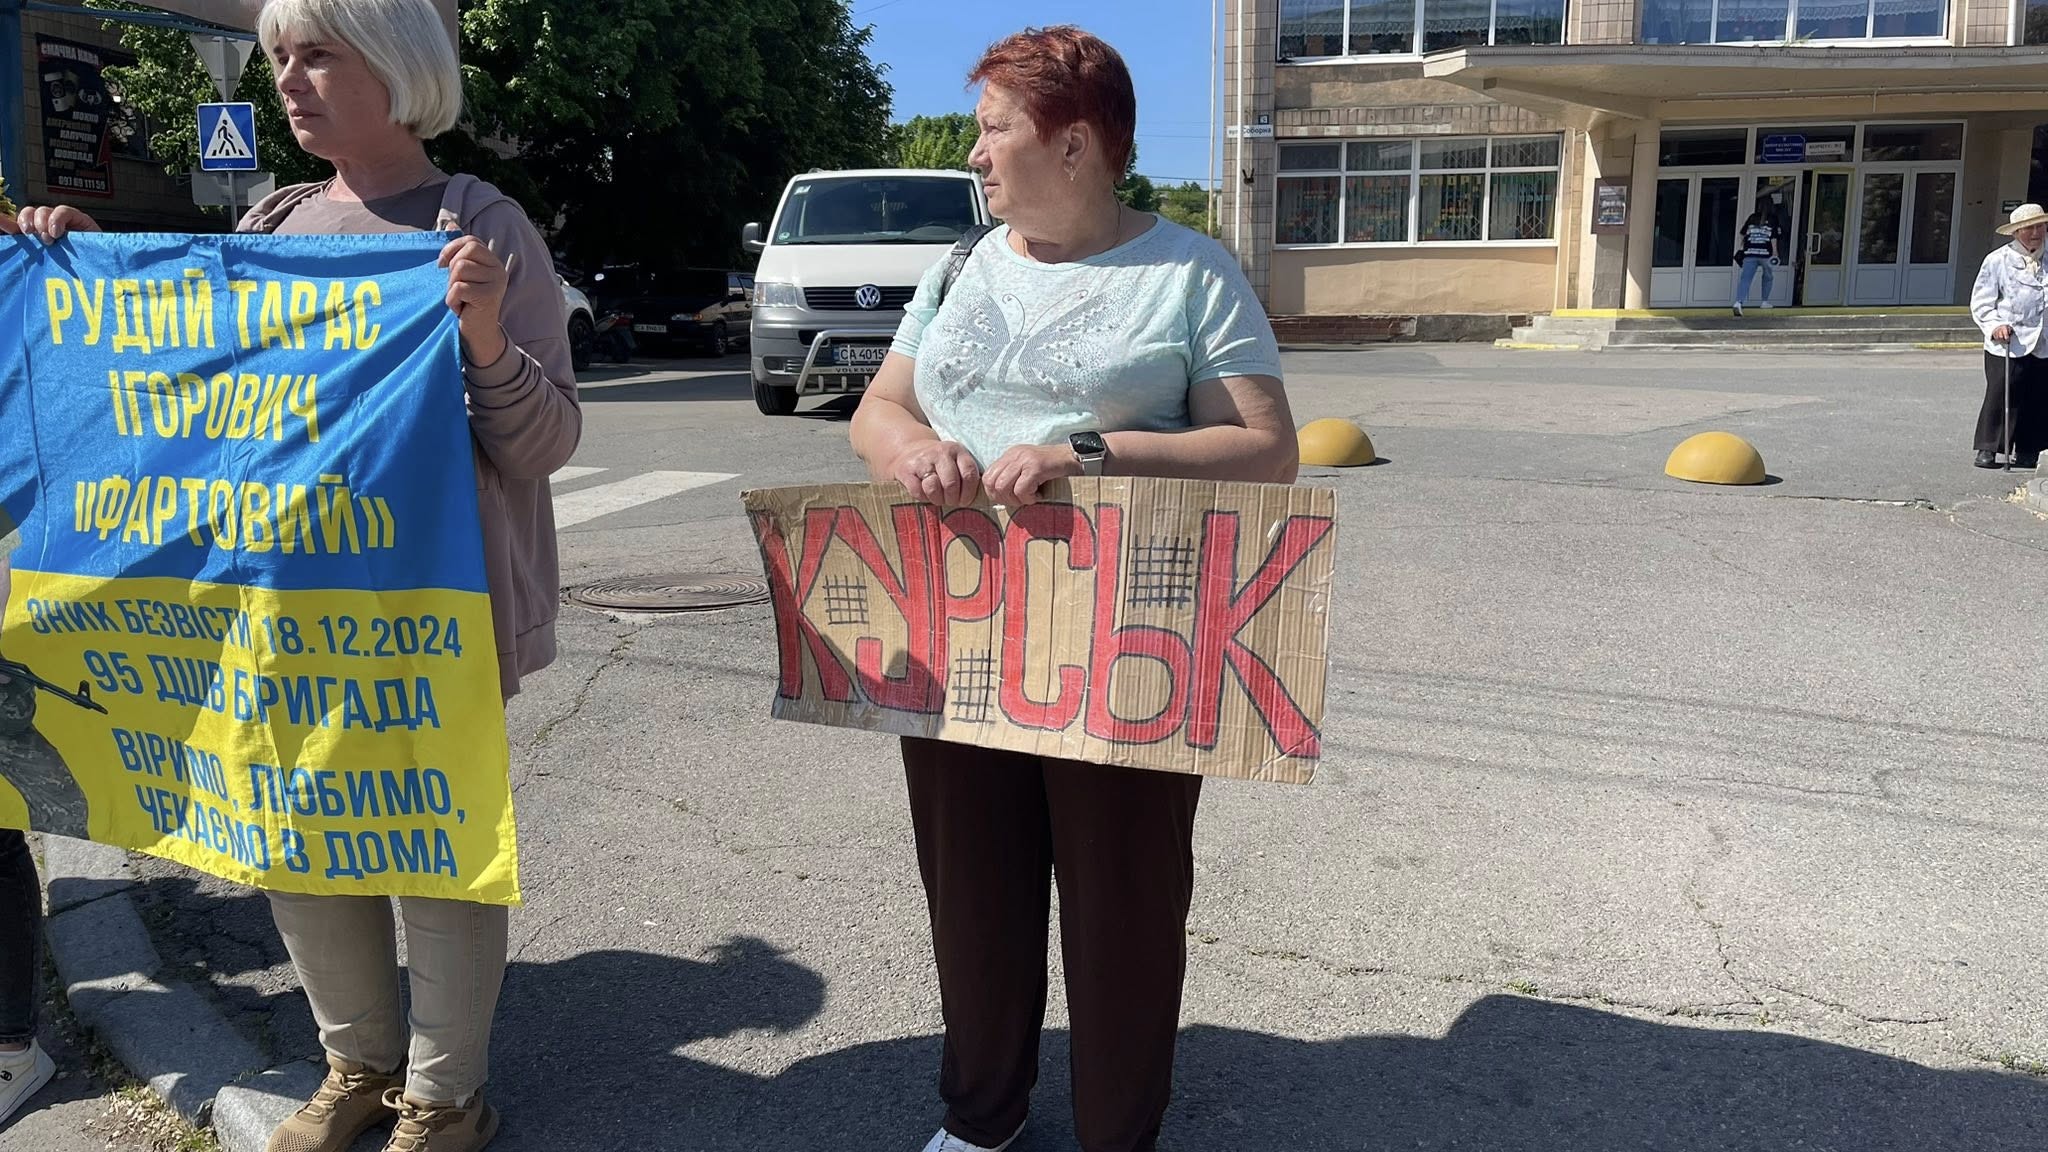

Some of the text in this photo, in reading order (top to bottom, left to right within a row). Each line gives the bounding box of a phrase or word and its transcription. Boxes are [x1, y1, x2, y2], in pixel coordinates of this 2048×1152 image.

[45, 268, 382, 355] РУДИЙ ТАРАС
[859, 349, 888, 360] 4015
[108, 370, 321, 443] ІГОРОВИЧ
[27, 597, 462, 658] ЗНИК БЕЗВІСТИ 18.12.2024
[749, 502, 1335, 759] КУРСЬК
[83, 649, 441, 734] 95 ДШВ БРИГАДА
[112, 727, 465, 824] ВІРИМО, ЛЮБИМО,
[135, 784, 458, 880] ЧЕКАЄМО В ДОМА
